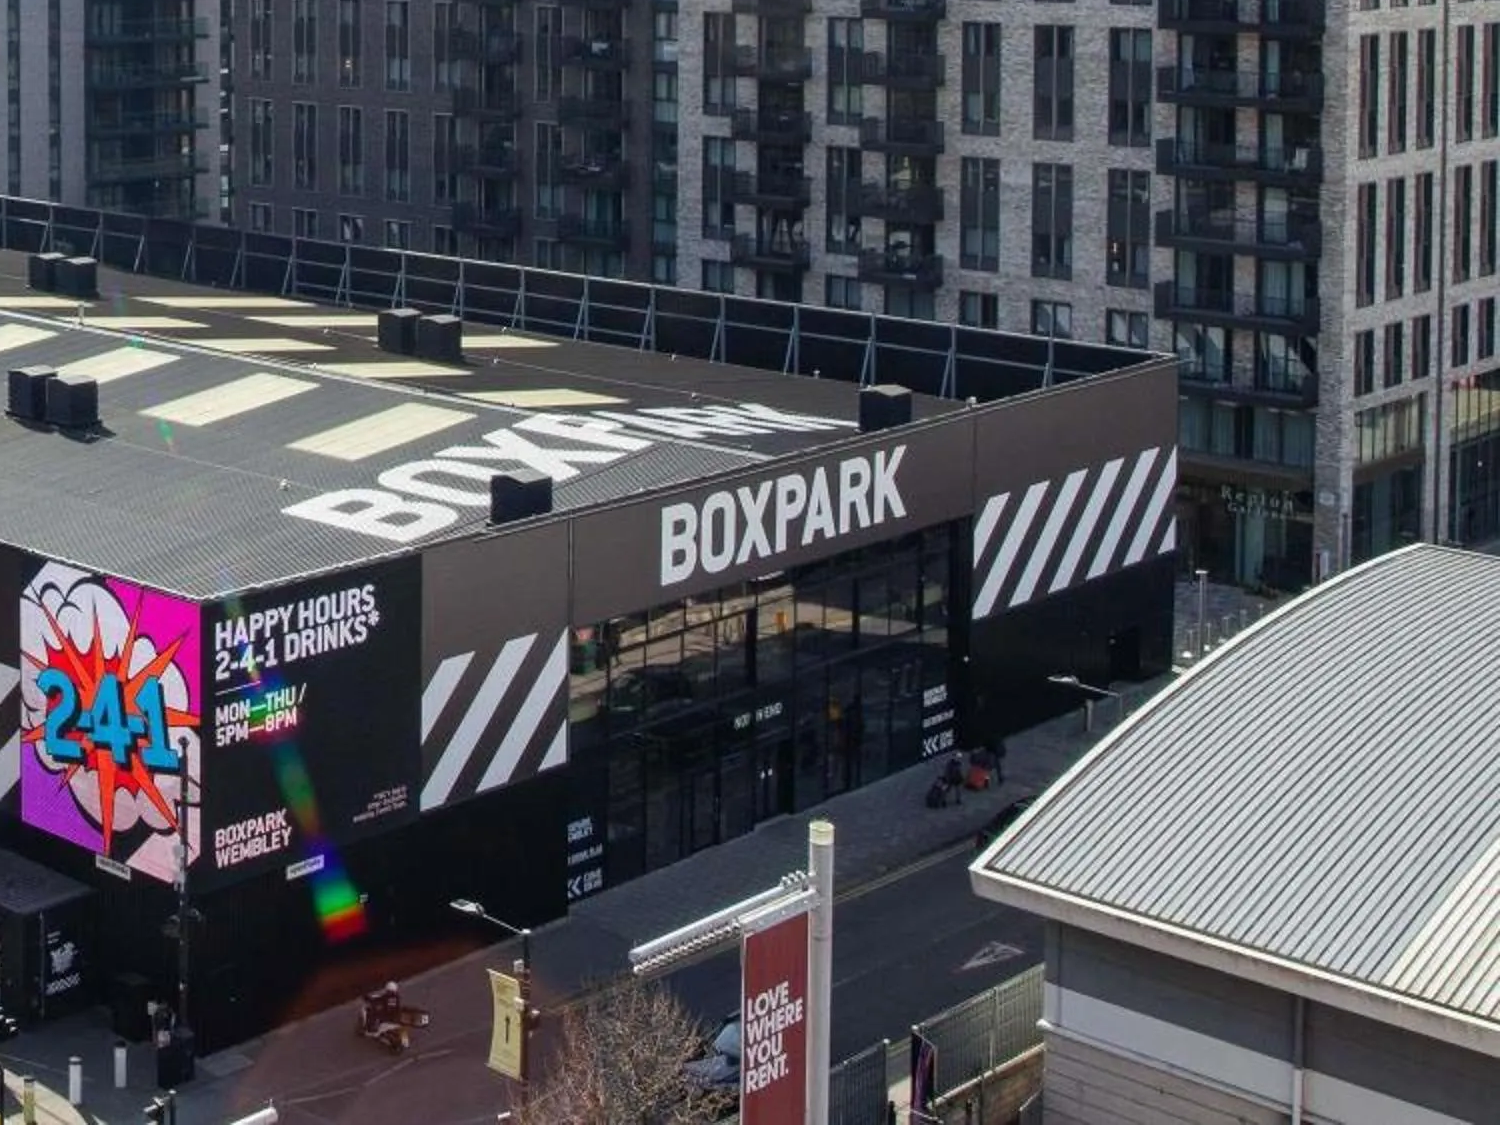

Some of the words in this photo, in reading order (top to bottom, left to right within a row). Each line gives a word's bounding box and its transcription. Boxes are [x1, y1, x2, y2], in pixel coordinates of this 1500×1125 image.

[660, 445, 907, 587] BOXPARK
[215, 603, 294, 651] HAPPY
[298, 584, 375, 630] HOURS
[215, 638, 278, 680] 2-4-1
[215, 807, 288, 849] BOXPARK
[215, 826, 292, 870] WEMBLEY
[746, 997, 804, 1045] WHERE
[747, 981, 789, 1022] LOVE
[746, 1032, 783, 1068] YOU
[746, 1053, 789, 1094] RENT.
